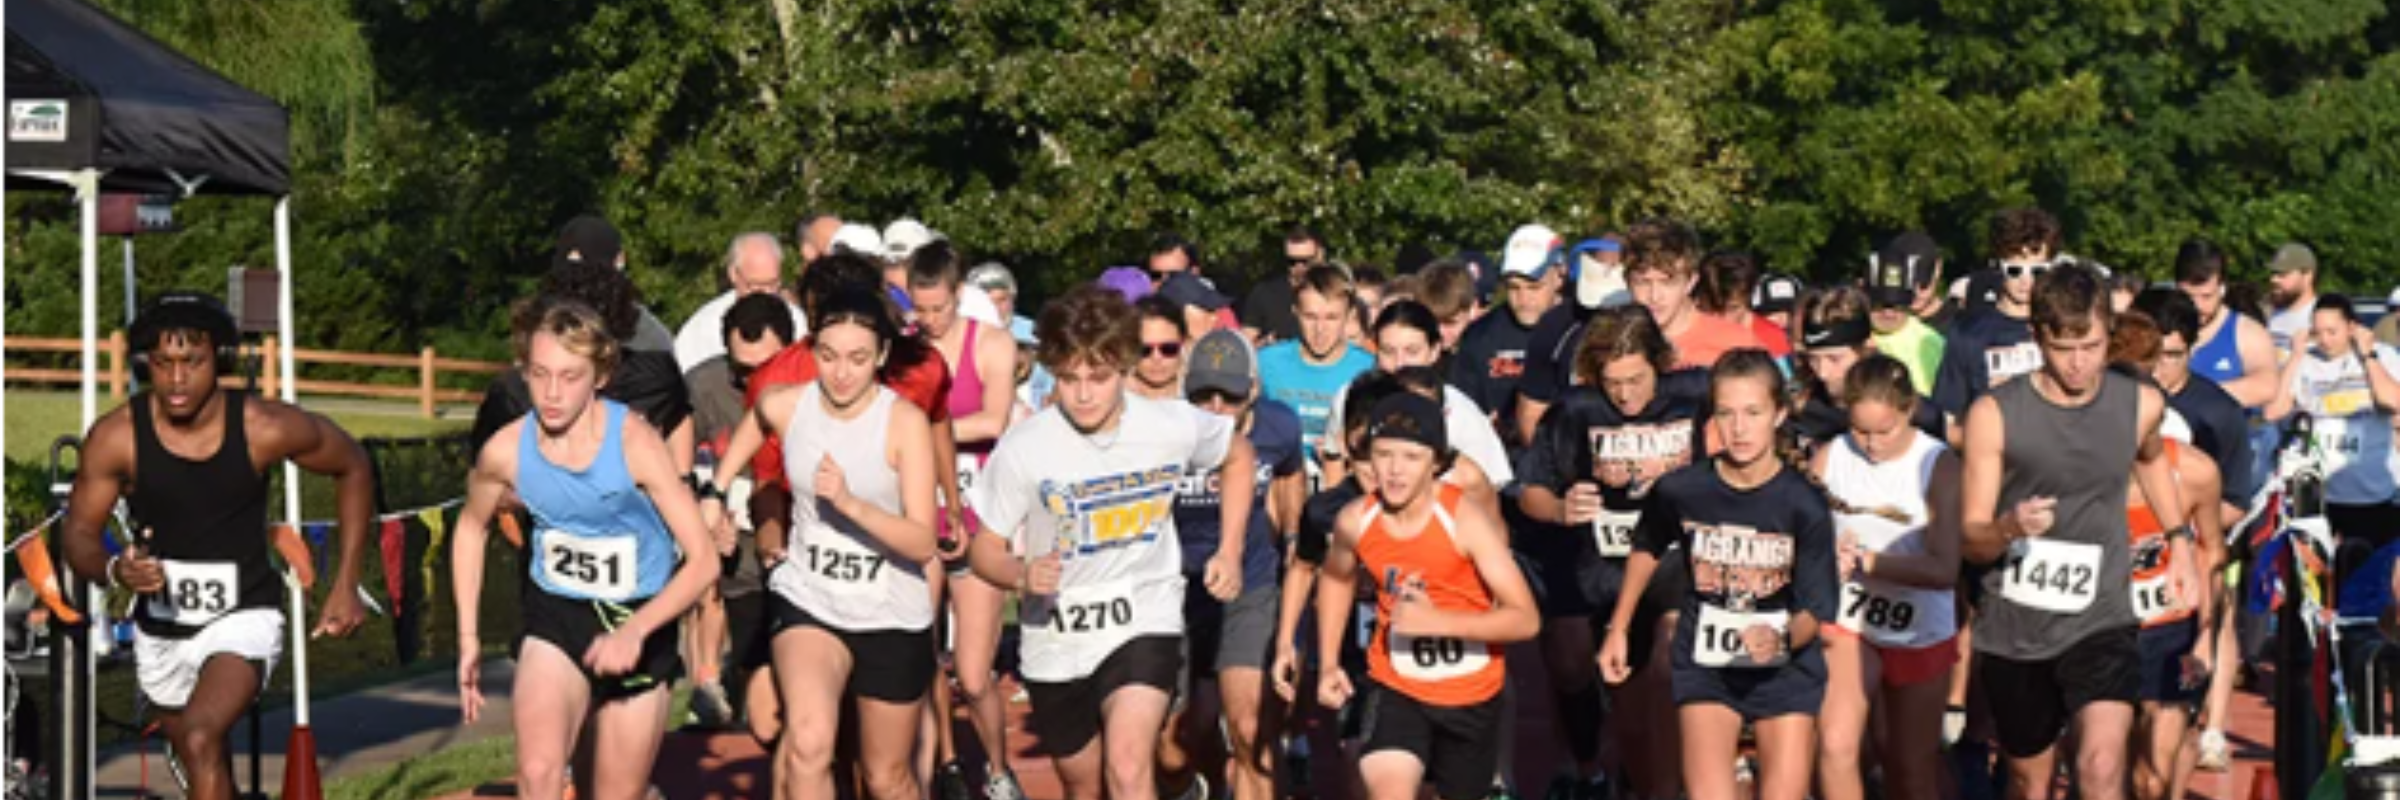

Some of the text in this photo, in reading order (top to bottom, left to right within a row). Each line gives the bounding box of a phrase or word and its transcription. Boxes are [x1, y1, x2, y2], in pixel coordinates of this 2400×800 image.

[1600, 524, 1636, 546] 13
[550, 545, 620, 587] 251
[806, 545, 884, 583] 1257
[2010, 556, 2092, 596] 1442
[1047, 597, 1133, 634] 1270
[1846, 587, 1914, 633] 789
[1701, 623, 1742, 653] 10
